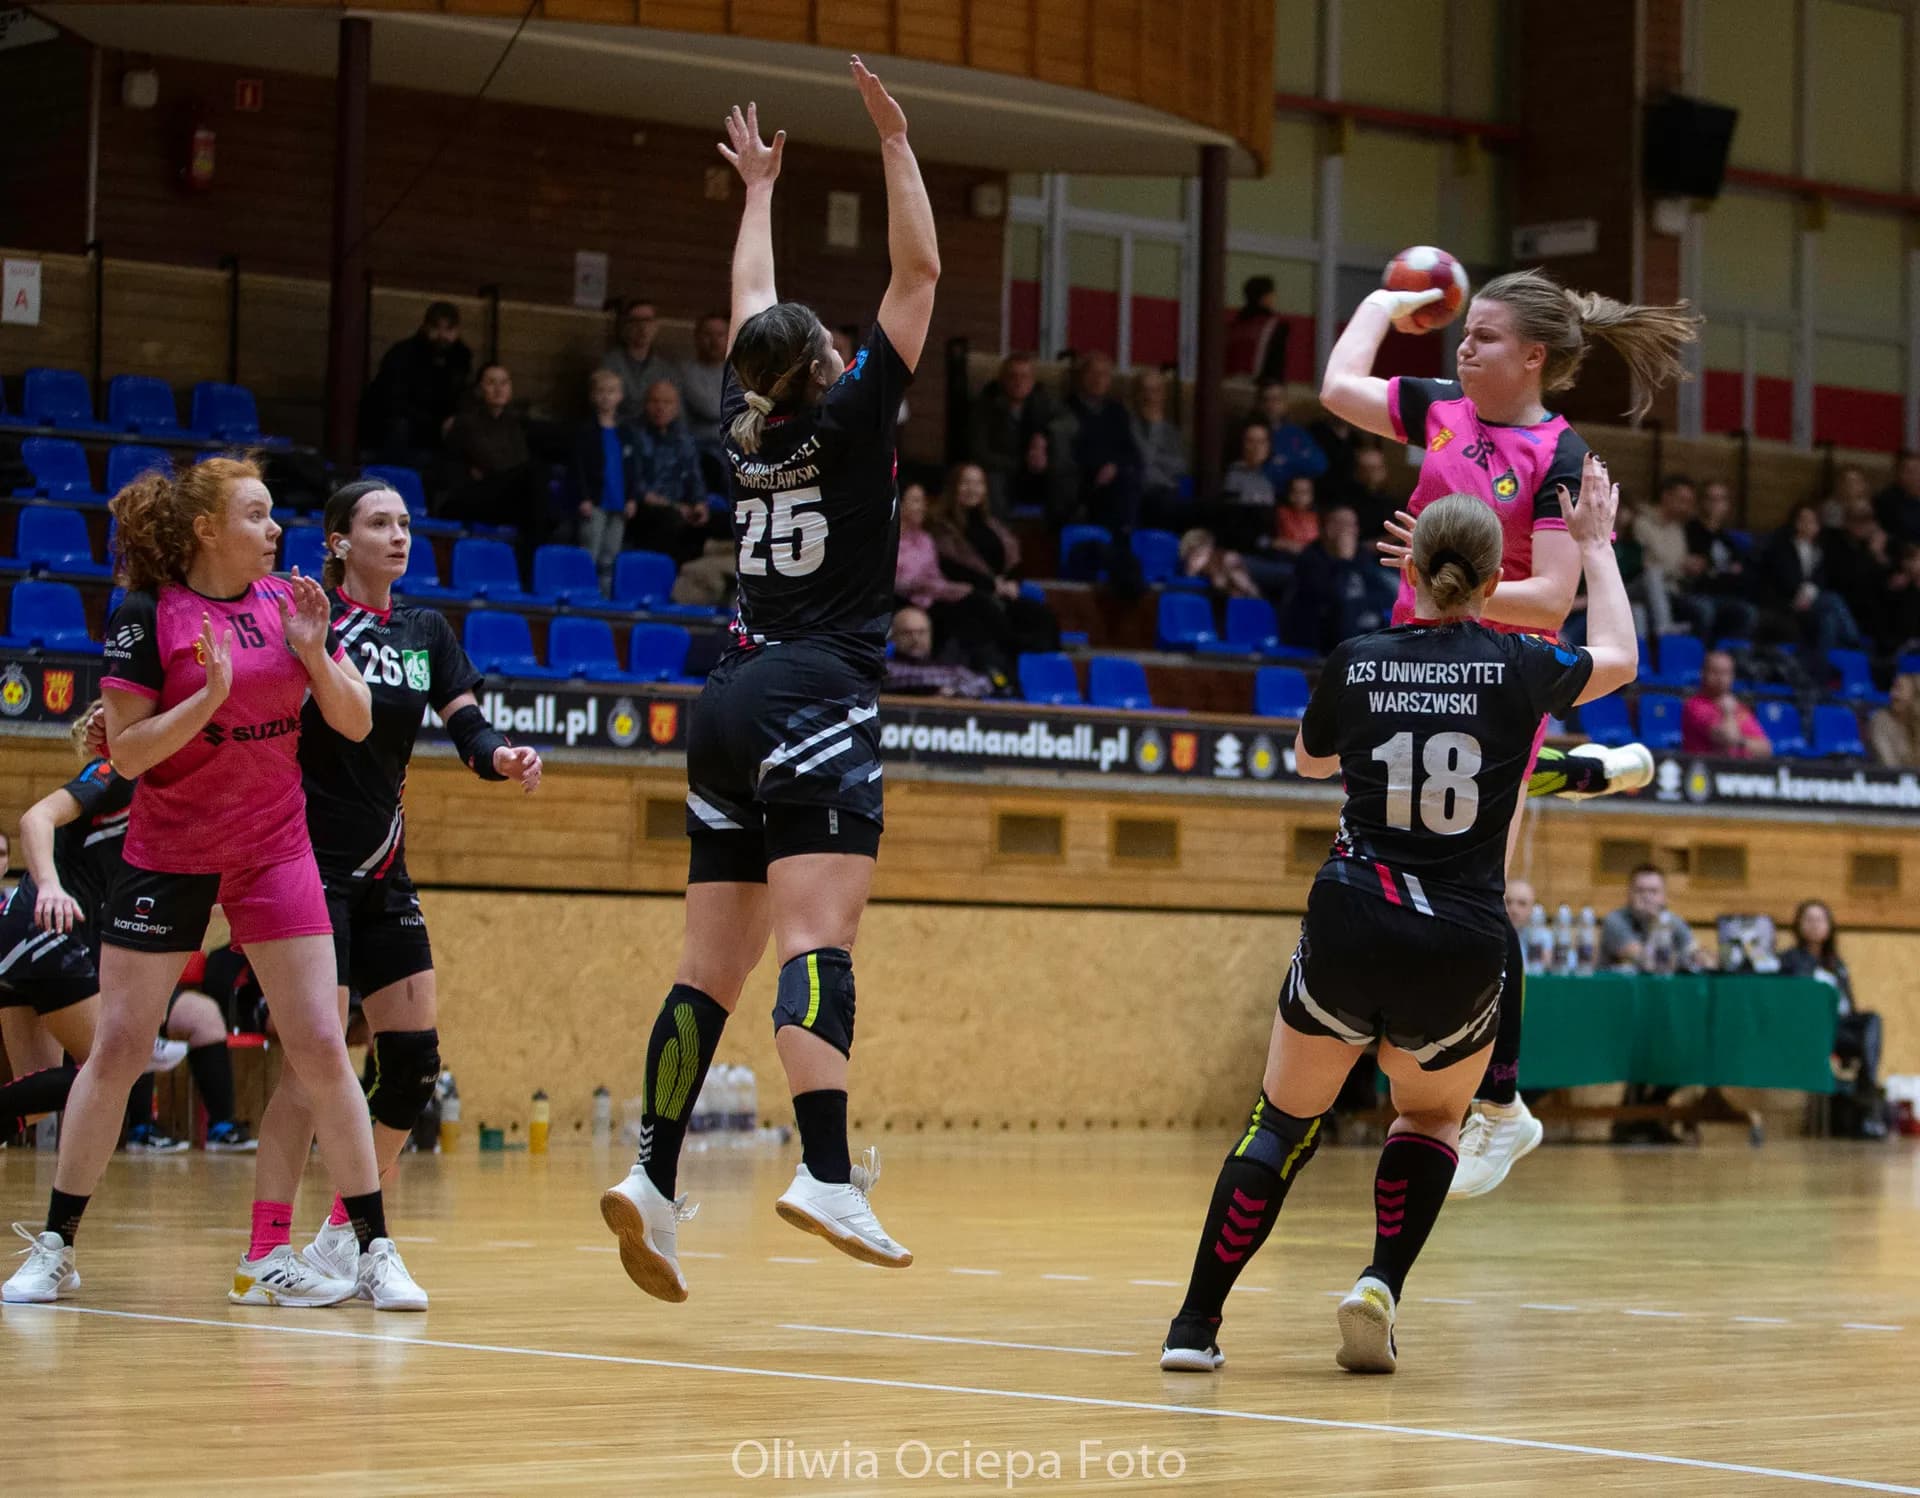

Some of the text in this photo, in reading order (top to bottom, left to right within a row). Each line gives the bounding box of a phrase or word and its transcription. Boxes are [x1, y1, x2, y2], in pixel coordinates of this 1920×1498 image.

[14, 287, 29, 311] A
[735, 486, 829, 577] 25
[226, 612, 266, 650] 15
[361, 641, 403, 687] 26
[1346, 660, 1505, 686] AZS UNIWERSYTET
[421, 692, 597, 746] dball.pl
[1368, 691, 1478, 716] WARSZWSKI
[232, 716, 301, 742] SUZUK
[880, 716, 1129, 773] oronahandball.pl
[1371, 731, 1483, 836] 18
